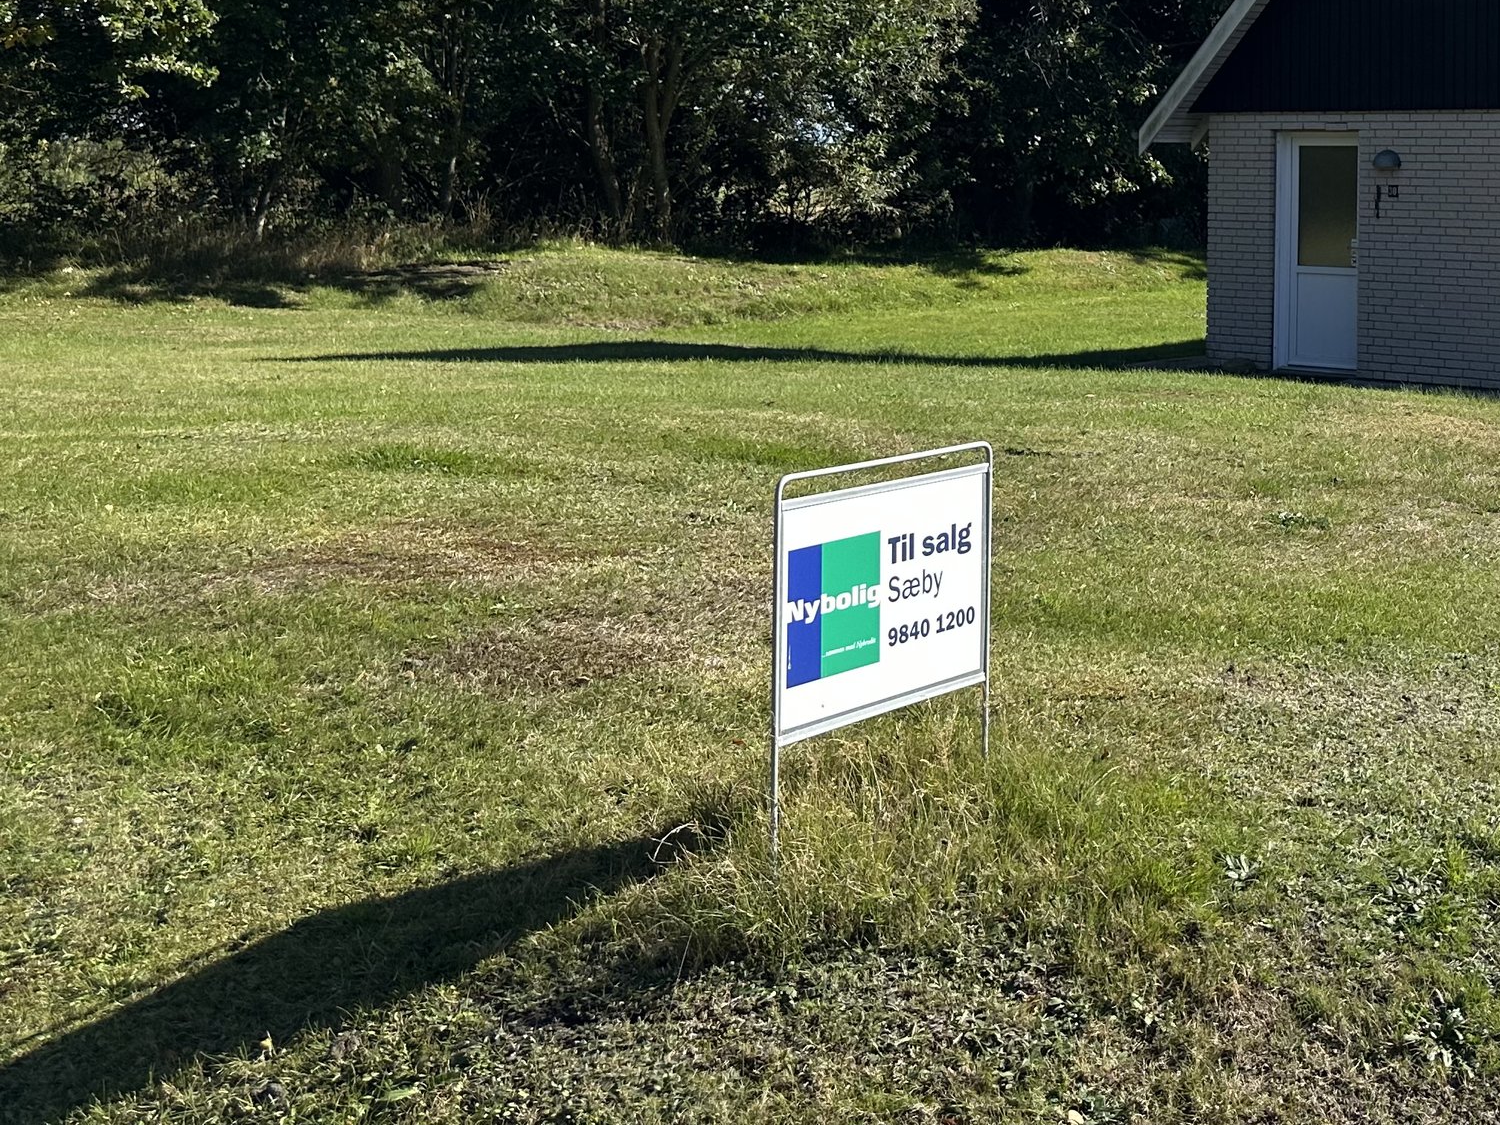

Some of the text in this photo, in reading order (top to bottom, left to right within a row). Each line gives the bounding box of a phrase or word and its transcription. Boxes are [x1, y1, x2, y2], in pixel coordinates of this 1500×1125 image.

[888, 522, 972, 565] Til salg
[786, 583, 881, 625] Nybolig
[888, 569, 943, 602] Sæby
[888, 606, 976, 647] 9840 1200
